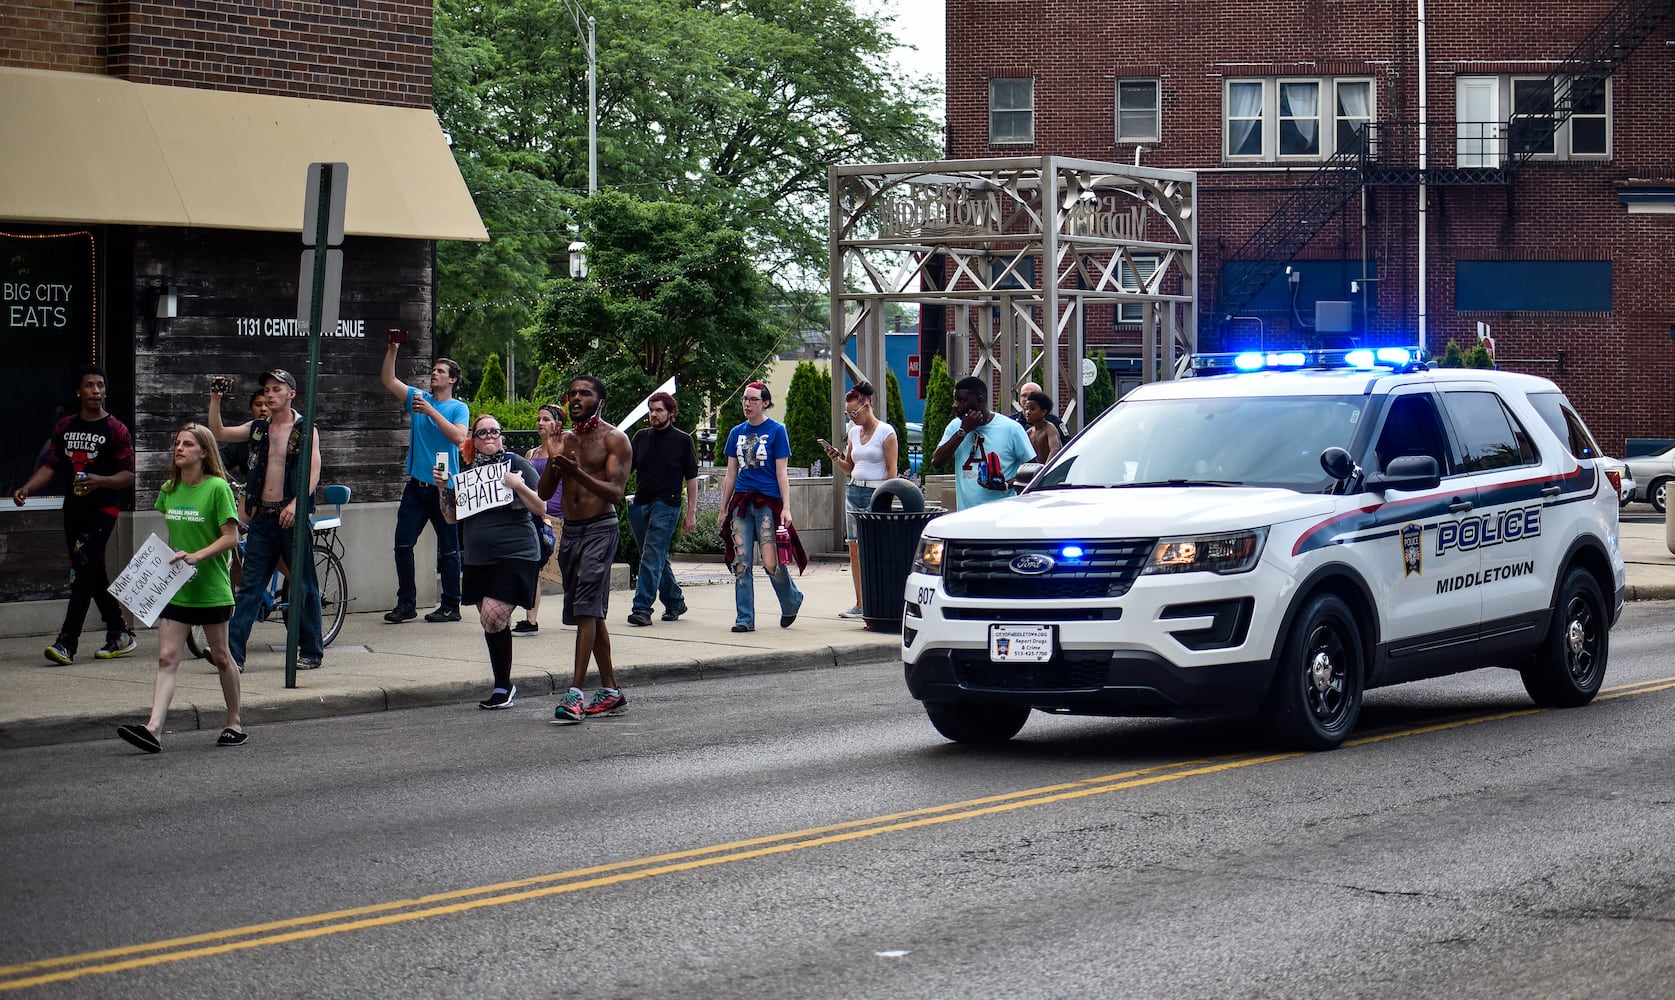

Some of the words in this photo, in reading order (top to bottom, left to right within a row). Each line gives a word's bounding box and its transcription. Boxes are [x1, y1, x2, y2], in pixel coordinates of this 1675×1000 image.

[4, 283, 31, 300] BIG
[36, 284, 73, 301] CITY
[10, 306, 67, 327] EATS
[237, 318, 261, 336] 1131
[64, 432, 106, 444] CHICAGO
[67, 441, 97, 451] BULLS
[456, 468, 483, 491] HEX
[487, 460, 511, 480] OUT
[467, 479, 504, 511] HATE
[1436, 504, 1542, 557] POLICE
[1017, 557, 1041, 569] Ford
[131, 569, 155, 595] EQUAL
[150, 556, 162, 568] TO
[1436, 560, 1534, 595] MIDDLETOWN
[918, 587, 935, 605] 807
